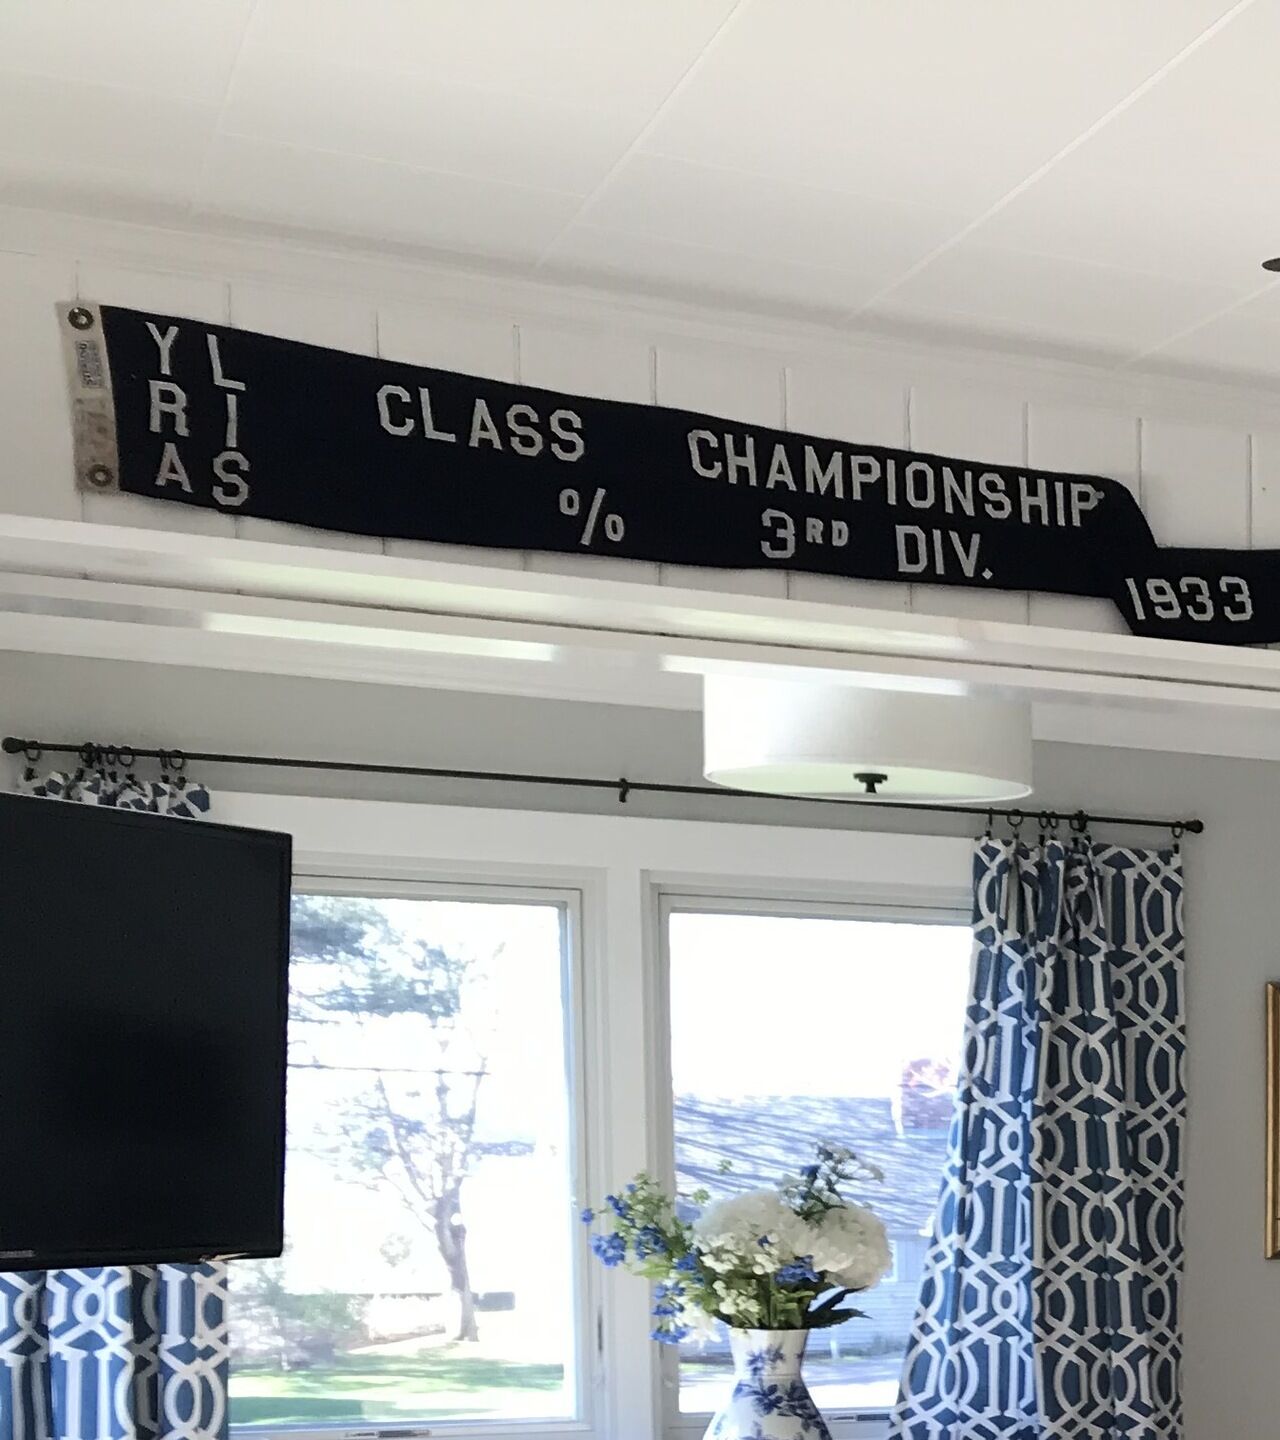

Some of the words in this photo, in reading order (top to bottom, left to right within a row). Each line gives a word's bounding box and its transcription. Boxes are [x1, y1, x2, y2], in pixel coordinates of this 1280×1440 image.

[376, 384, 585, 462] CLASS
[687, 429, 1106, 527] CHAMPIONSHIP
[761, 508, 849, 560] 3RD
[896, 524, 994, 580] DIV.
[1125, 576, 1254, 622] 1933
